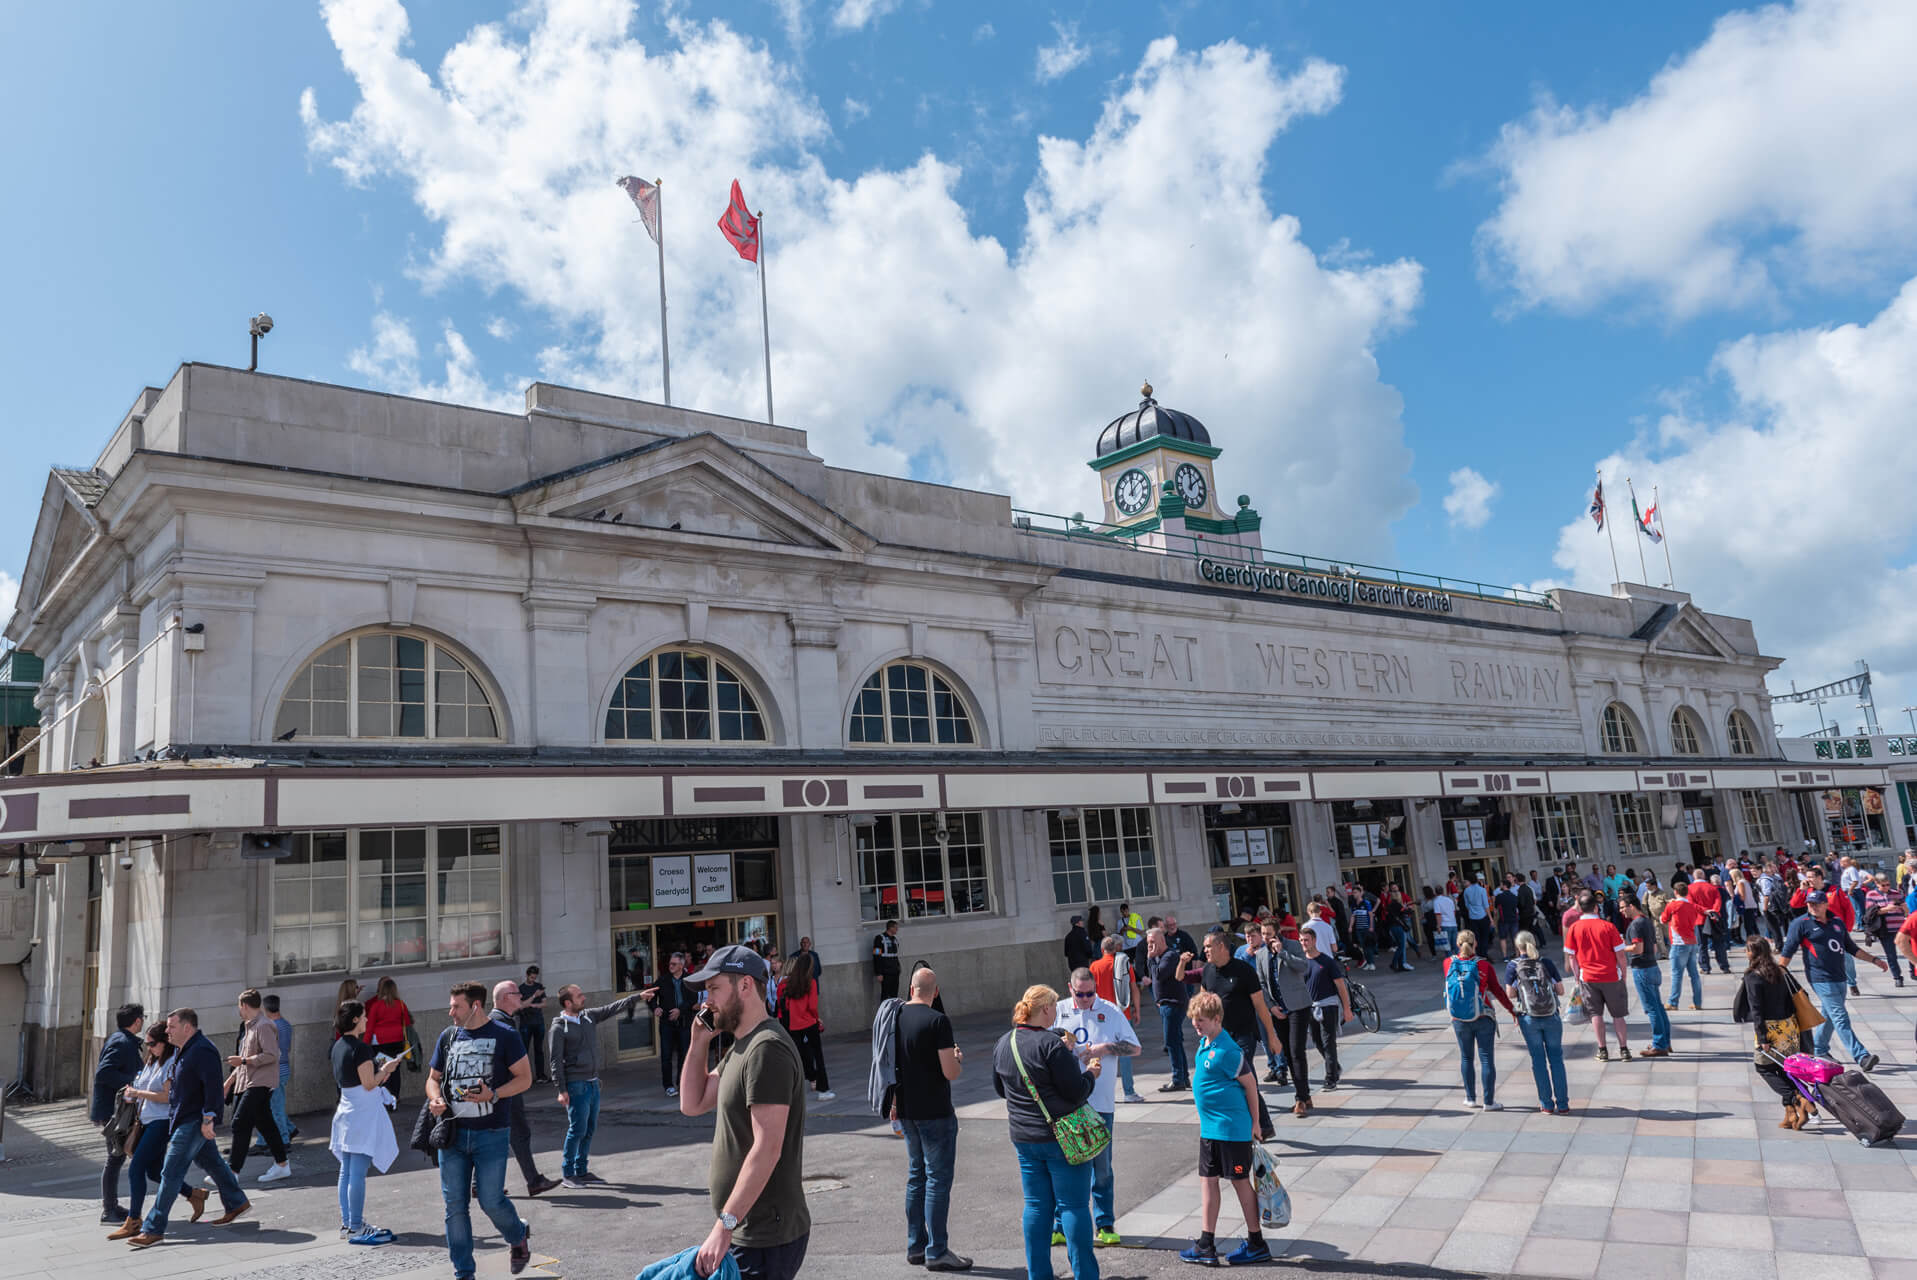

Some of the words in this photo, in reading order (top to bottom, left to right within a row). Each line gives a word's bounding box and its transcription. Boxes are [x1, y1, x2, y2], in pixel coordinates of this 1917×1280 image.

[1198, 558, 1284, 593] Caerdydd
[1404, 588, 1453, 612] Central
[1055, 625, 1198, 682] GREAT
[1255, 642, 1415, 694] WESTERN
[1448, 660, 1560, 703] RAILWAY
[659, 868, 684, 876] Croeso
[697, 865, 728, 874] Welcome
[710, 875, 716, 883] to
[655, 887, 689, 896] Gaerdydd
[702, 884, 725, 893] Cardiff
